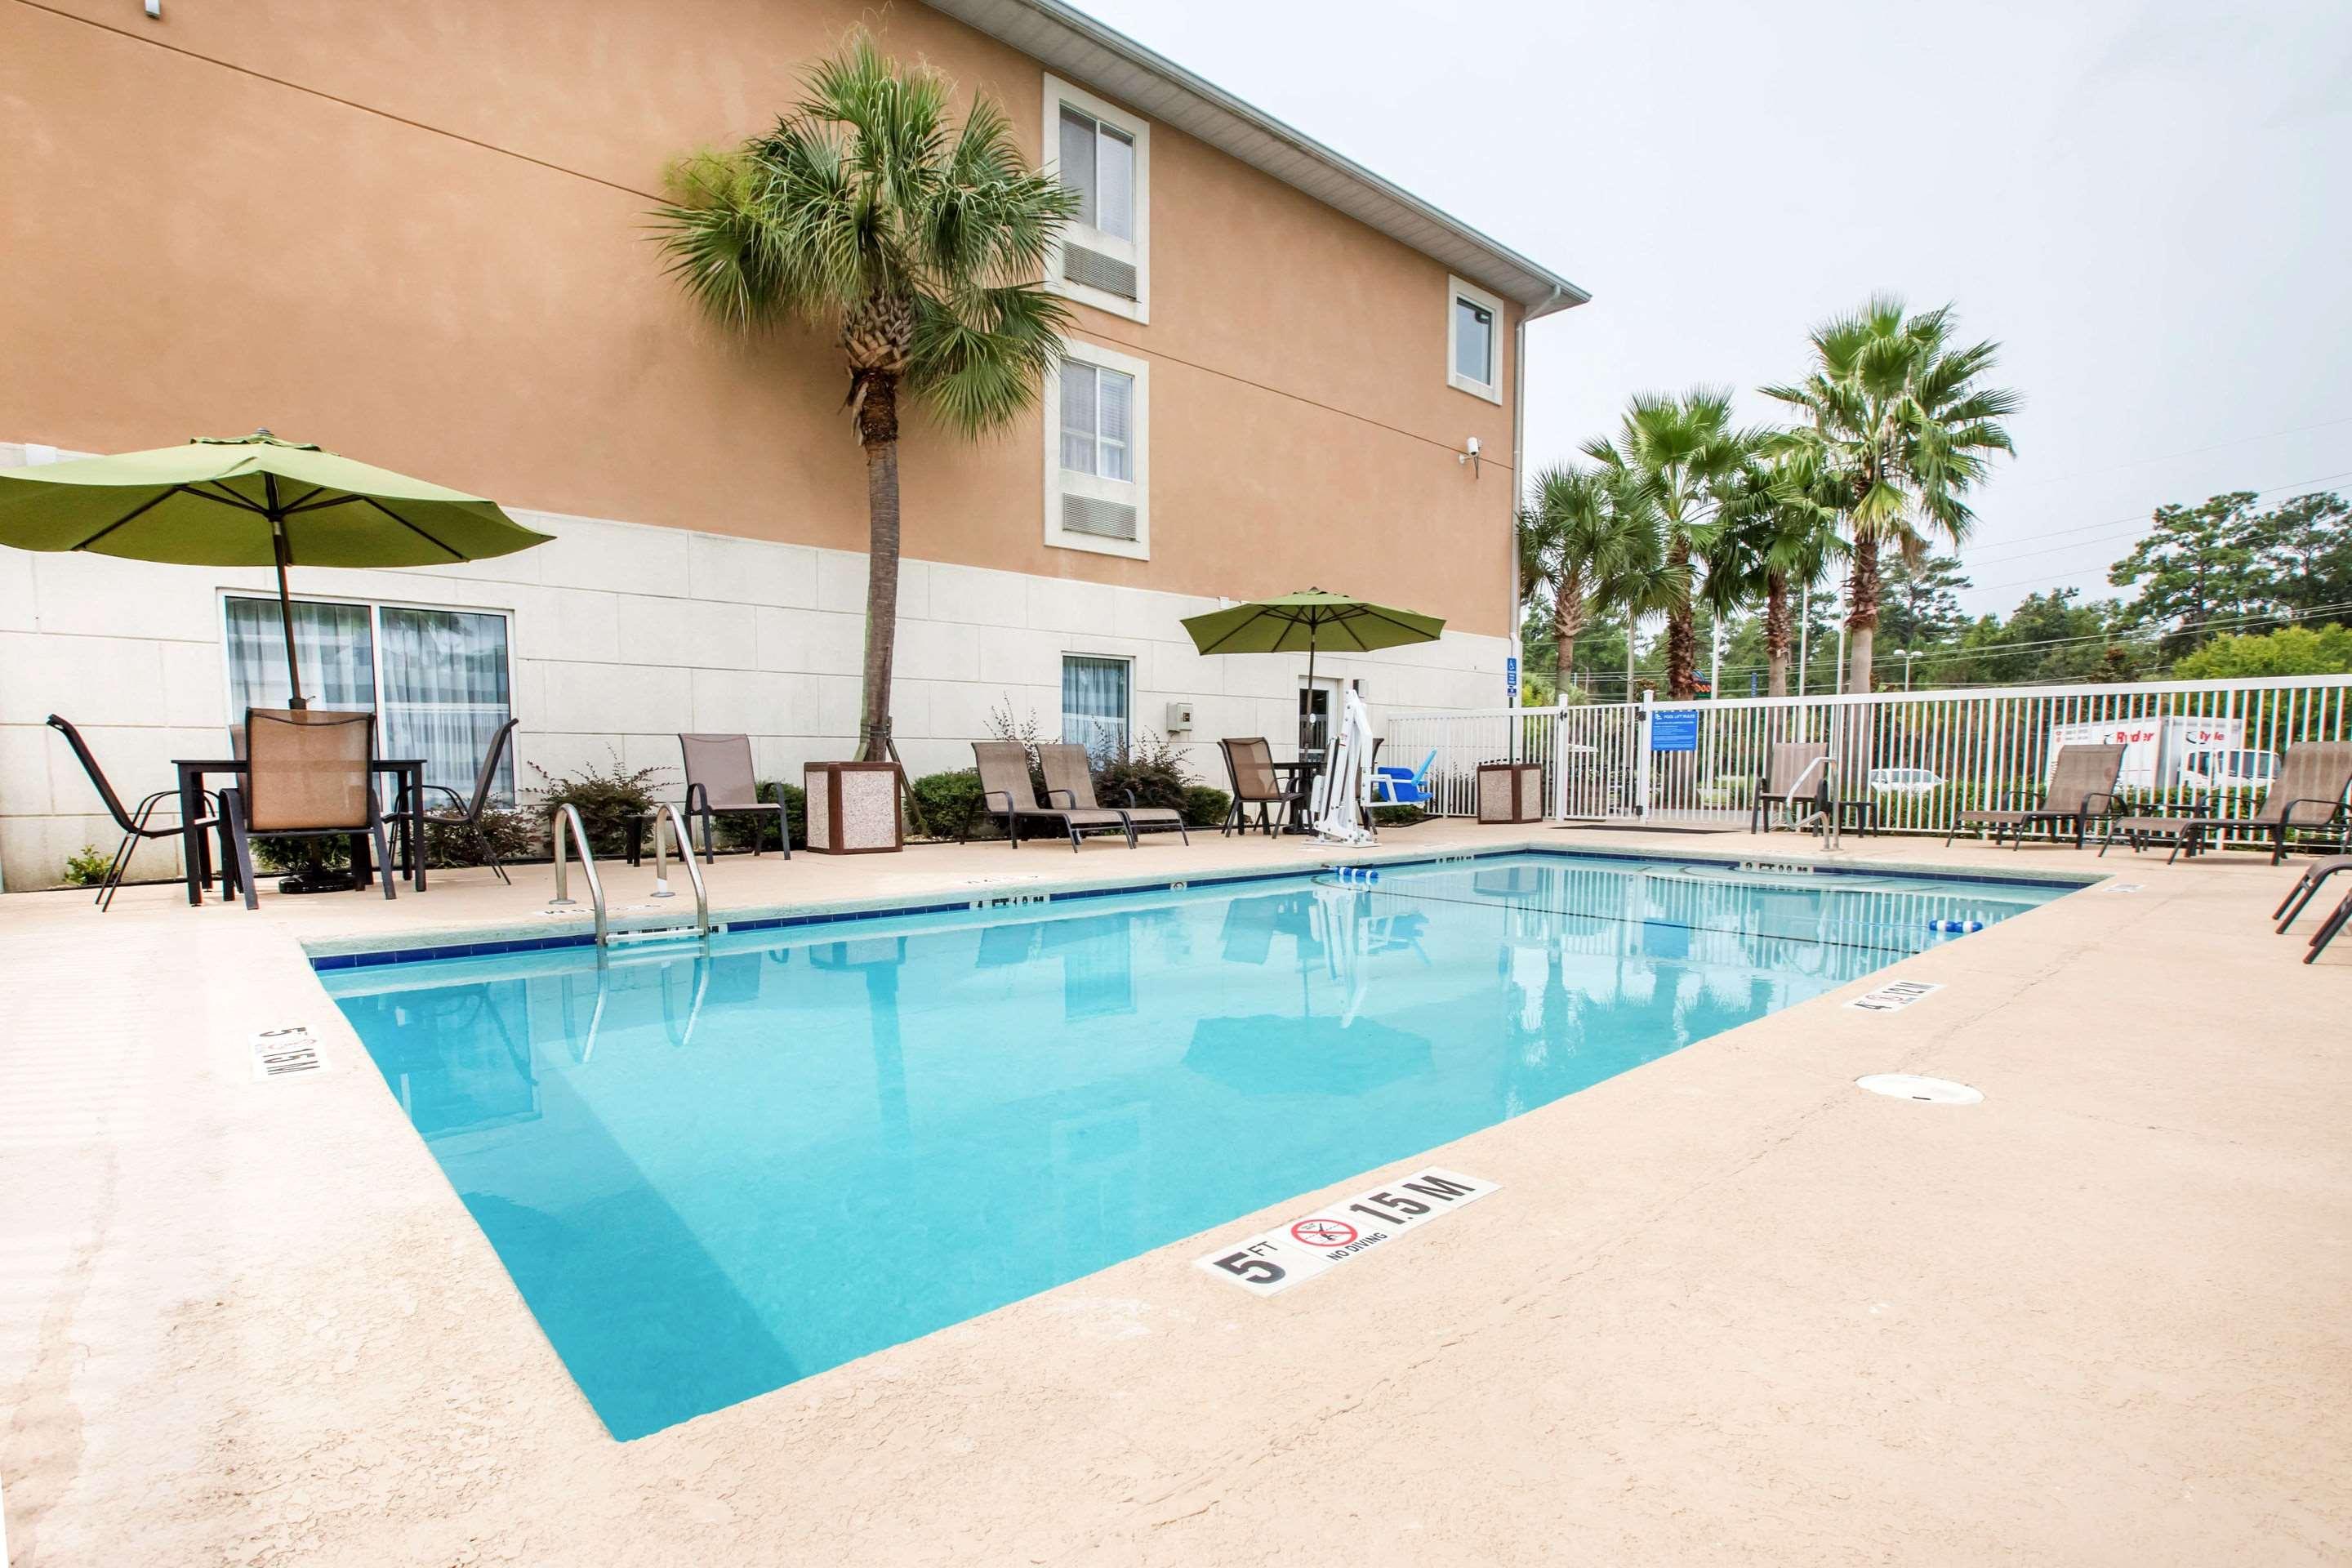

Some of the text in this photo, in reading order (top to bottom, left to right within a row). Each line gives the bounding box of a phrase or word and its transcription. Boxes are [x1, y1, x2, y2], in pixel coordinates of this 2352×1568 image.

[1402, 1174, 1476, 1202] M
[1247, 1241, 1279, 1258] FT
[1326, 1232, 1388, 1261] NO DIVING
[1213, 1251, 1286, 1285] 5
